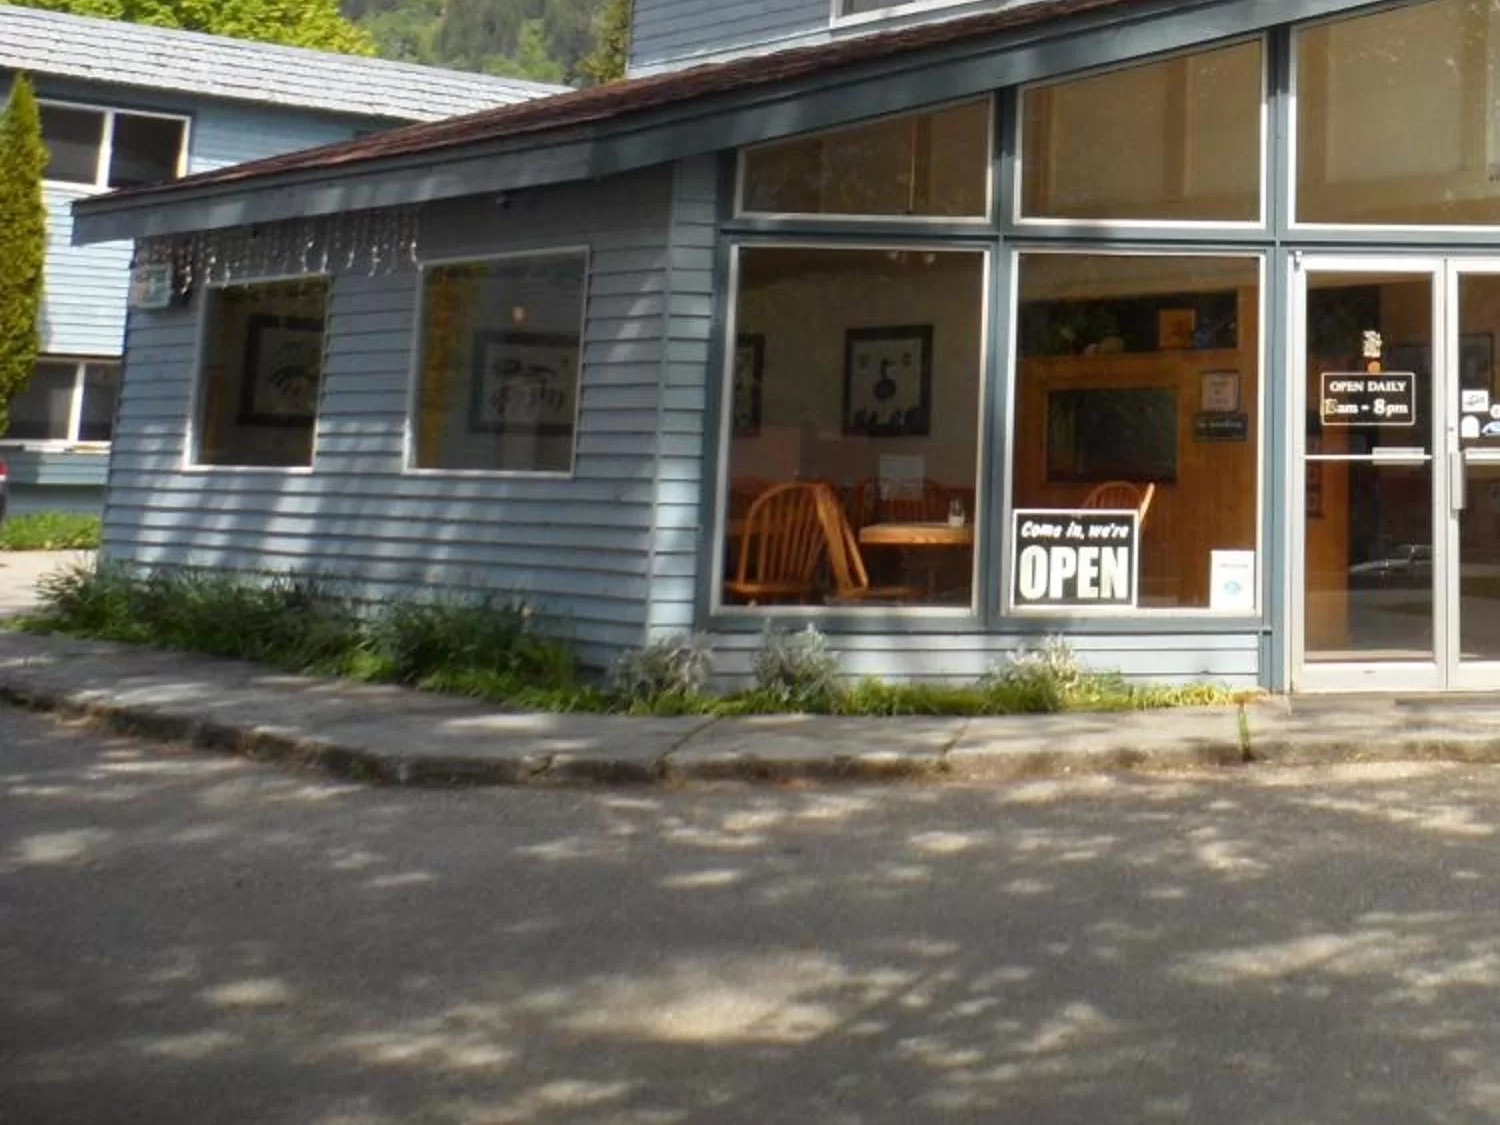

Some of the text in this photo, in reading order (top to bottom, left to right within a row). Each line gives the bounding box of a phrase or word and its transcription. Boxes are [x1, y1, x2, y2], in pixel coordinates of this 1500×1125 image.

[1329, 380, 1406, 392] OPEN DAILY
[1373, 398, 1409, 418] 8pm
[1021, 520, 1130, 540] Come in, we're
[1019, 544, 1130, 600] OPEN
